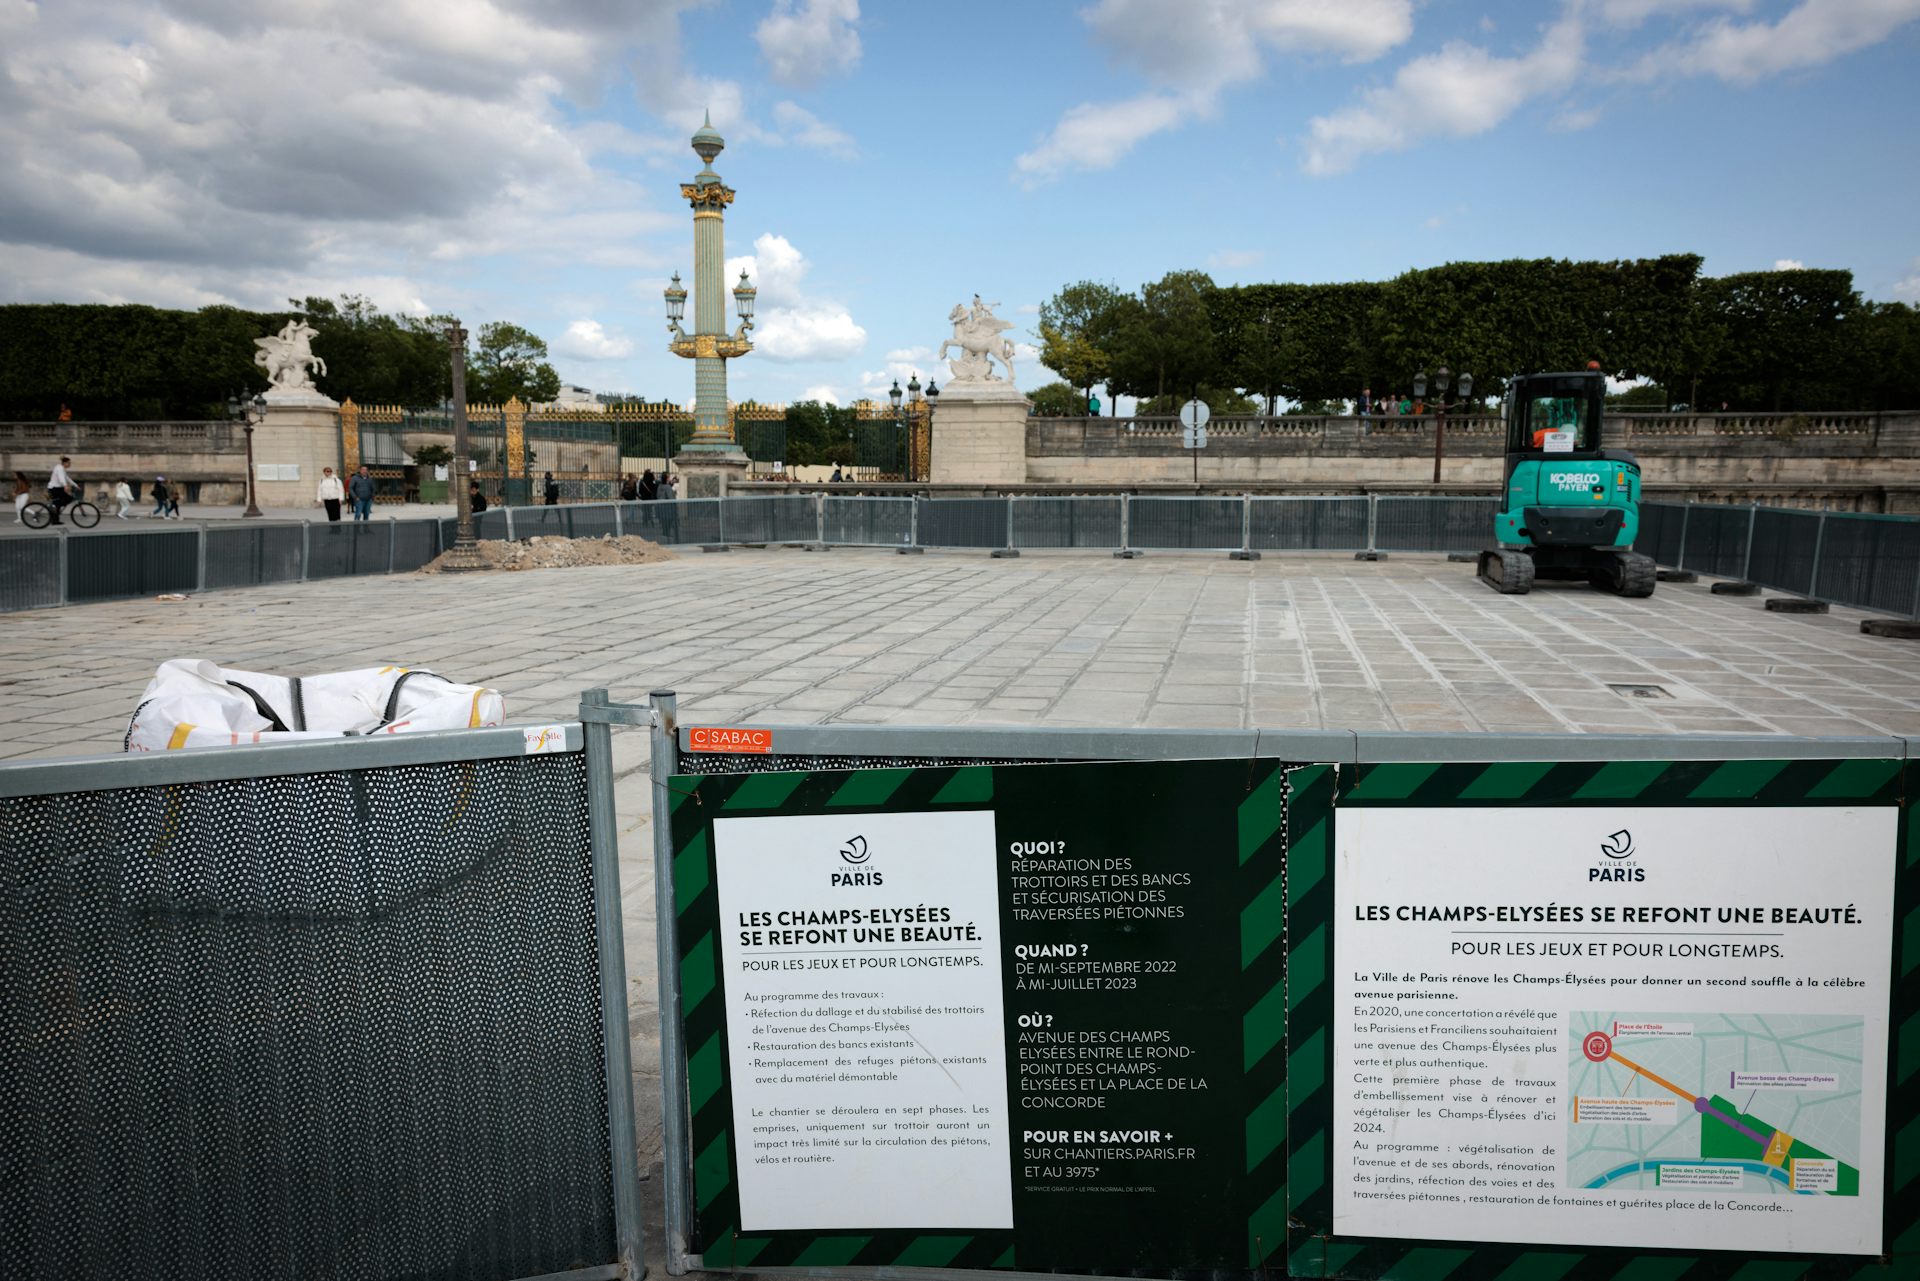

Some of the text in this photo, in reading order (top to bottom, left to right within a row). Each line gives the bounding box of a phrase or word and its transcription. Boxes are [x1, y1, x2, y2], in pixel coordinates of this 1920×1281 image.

[1550, 473, 1600, 484] KOBELCO
[1012, 857, 1132, 872] RÉPARATION DES
[832, 873, 882, 886] PARIS
[1011, 873, 1191, 888] TROTTOIRS ET DES BANCS
[1589, 868, 1645, 882] PARIS
[1013, 890, 1166, 904] ET SÉCURISATION DES
[740, 904, 950, 927] LES CHAMPS-ELYSÉES
[1013, 905, 1184, 920] TRAVERSÉES PIÉTONNES
[1356, 902, 1862, 924] LES CHAMPS-ELYSÉES SE REFONT UNE BEAUTÉ.
[740, 922, 981, 946] SE REFONT UNE BEAUTÉ.
[1015, 944, 1077, 960] QUAND
[1452, 942, 1783, 957] POUR LES JEUX ET POUR LONGTEMPS.
[743, 956, 983, 971] POUR LES JEUX ET POUR LONGTEMPS.
[1016, 961, 1176, 974] DE MI-SEPTEMBRE 2022
[1016, 976, 1136, 990] À MI-JUILLET 2023
[1355, 972, 1368, 981] La
[1373, 972, 1398, 982] Ville
[1402, 973, 1415, 982] de
[1420, 973, 1448, 982] Paris
[1494, 974, 1508, 983] les
[1514, 972, 1606, 986] Champs-Élysées
[1642, 976, 1682, 985] donner
[1706, 977, 1746, 986] second
[1752, 977, 1790, 986] souffle
[1796, 978, 1802, 986] à
[1808, 977, 1818, 986] la
[1824, 978, 1865, 987] célèbre
[744, 993, 758, 1001] Au
[761, 994, 819, 1003] programme
[822, 990, 838, 999] des
[1397, 990, 1458, 1000] parisienne.
[751, 1009, 797, 1018] Réfection
[800, 1008, 812, 1016] du
[816, 1007, 852, 1018] dallage
[867, 1006, 880, 1015] du
[883, 1006, 922, 1014] stabilisé
[925, 1005, 942, 1014] des
[1354, 1006, 1367, 1015] En
[1370, 1006, 1402, 1017] 2020,
[1504, 1009, 1535, 1018] révélé
[752, 1025, 764, 1034] de
[810, 1024, 826, 1032] des
[828, 1022, 910, 1033] Champs-Elysées
[1018, 1031, 1170, 1043] AVENUE DES CHAMPS
[753, 1042, 816, 1050] Restauration
[820, 1040, 836, 1049] des
[839, 1040, 867, 1048] bancs
[1020, 1046, 1195, 1059] ELYSÉES ENTRE LE ROND-
[1021, 1063, 1161, 1074] POINT DES CHAMPS-
[1396, 1057, 1416, 1068] plus
[1420, 1058, 1488, 1069] authentique.
[1021, 1077, 1207, 1090] ÉLYSÉES ET LA PLACE DE LA
[1022, 1097, 1105, 1108] CONCORDE
[1024, 1131, 1068, 1143] POUR
[1074, 1131, 1095, 1143] EN
[1100, 1131, 1160, 1143] SAVOIR
[1024, 1148, 1195, 1159] SUR CHANTIERS.PARIS.FR
[1025, 1166, 1040, 1177] ET
[1043, 1167, 1062, 1177] AU
